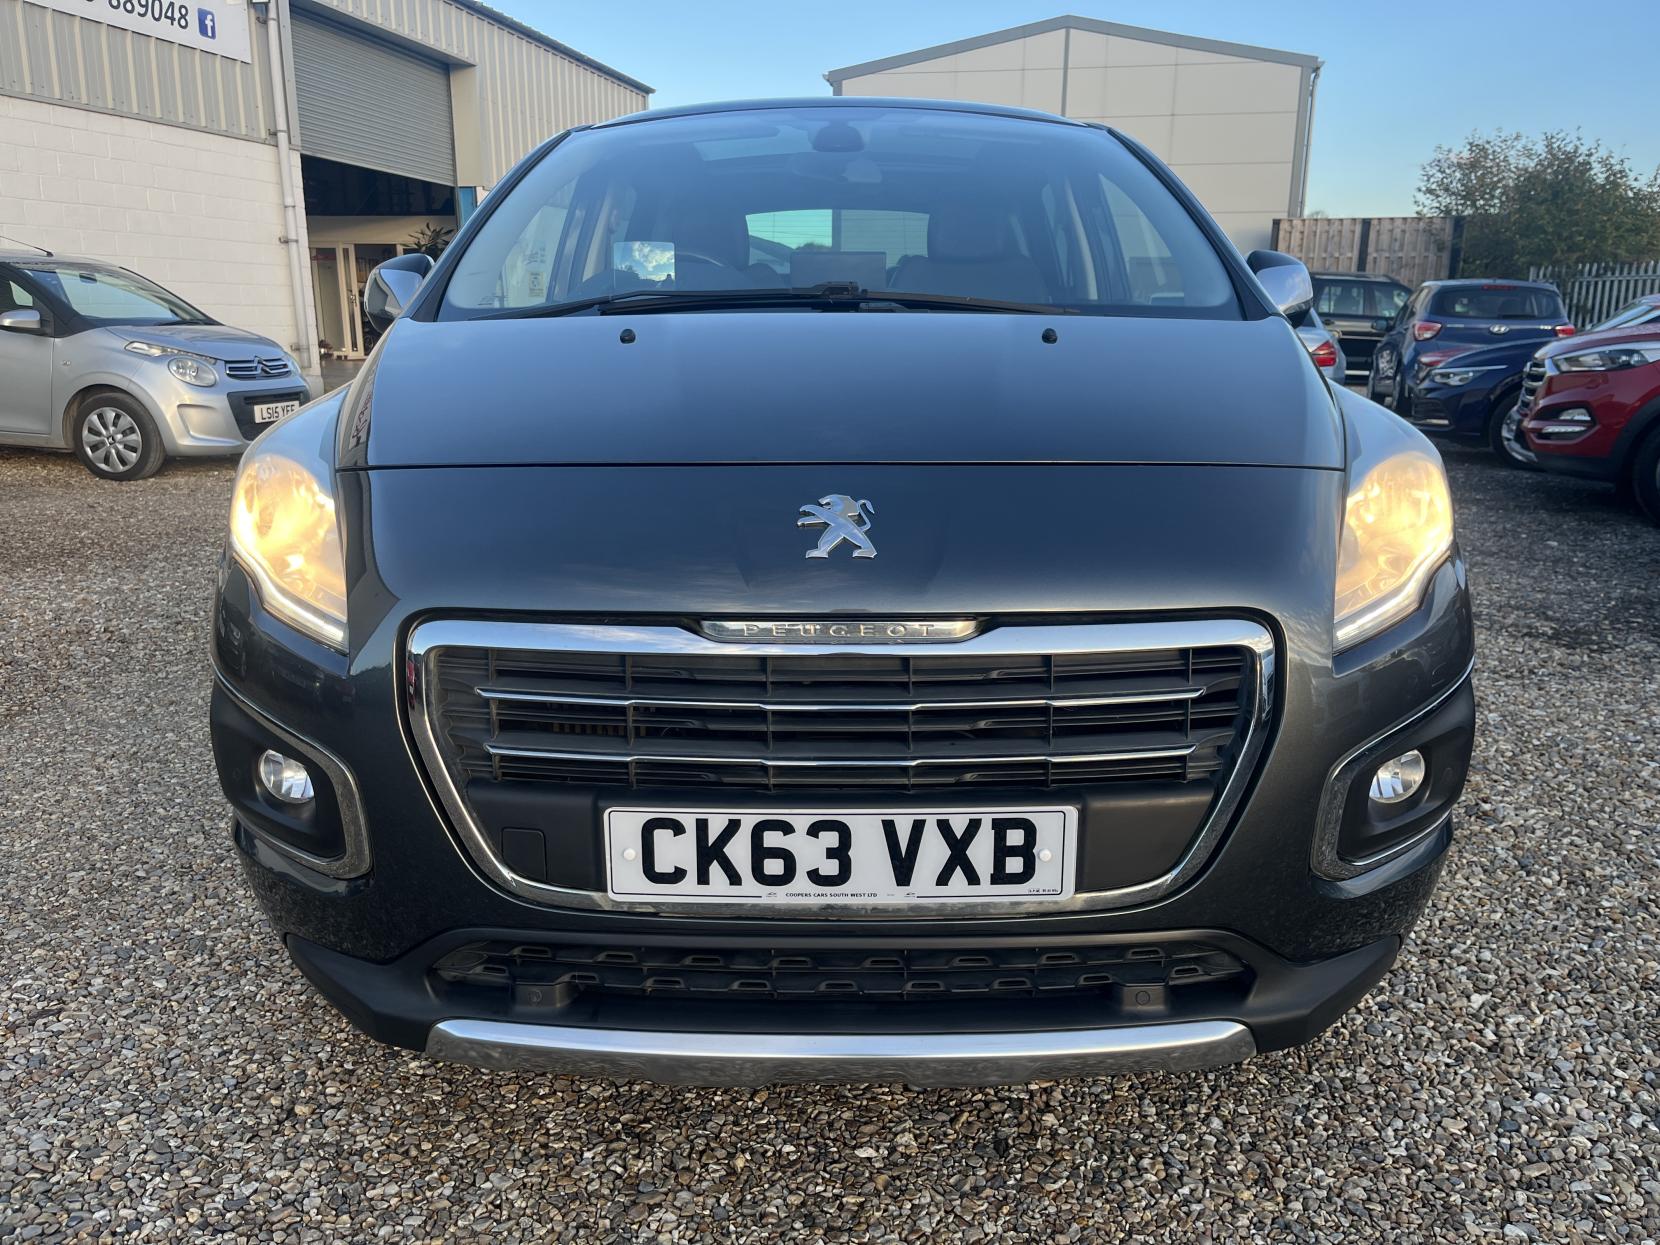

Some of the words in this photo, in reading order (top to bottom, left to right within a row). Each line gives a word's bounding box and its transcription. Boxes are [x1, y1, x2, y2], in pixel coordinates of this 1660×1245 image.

[261, 407, 280, 420] LS15
[743, 623, 935, 637] PEUGEOT
[641, 817, 852, 887] CK63
[881, 817, 1038, 887] VXB
